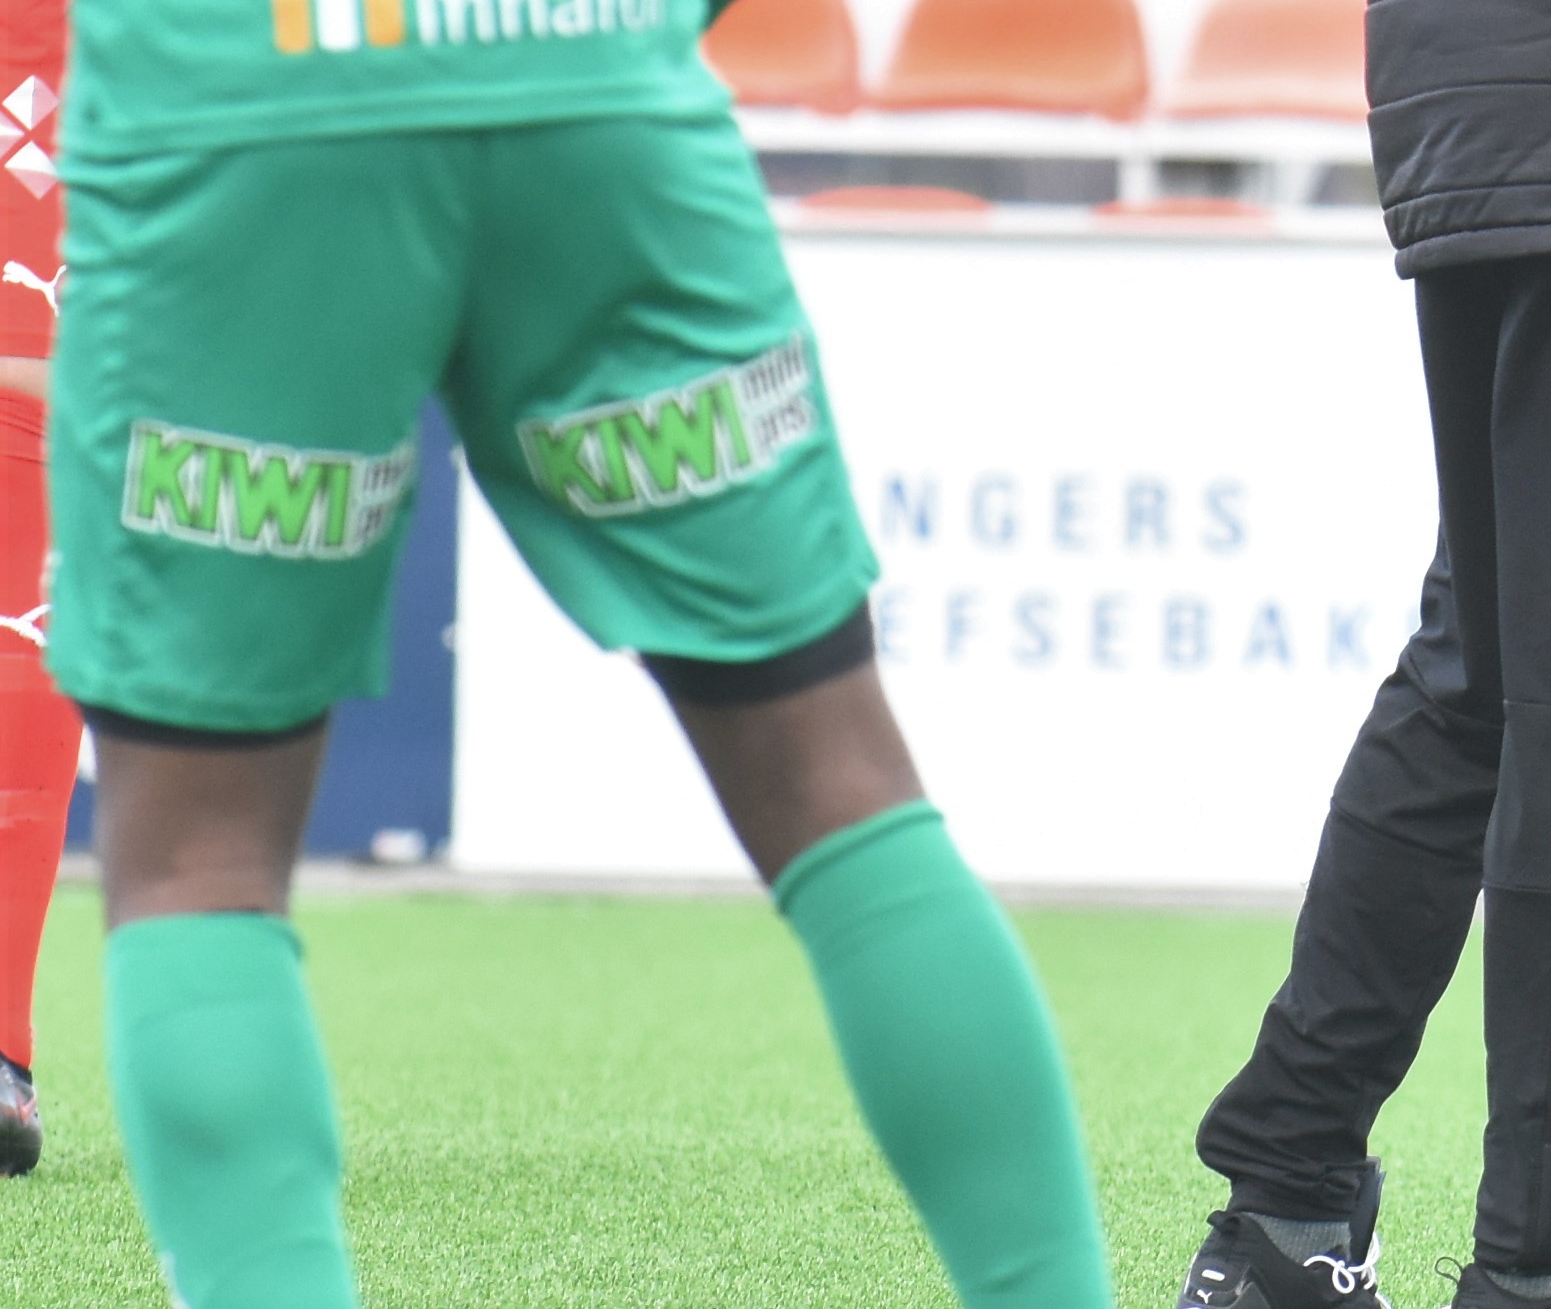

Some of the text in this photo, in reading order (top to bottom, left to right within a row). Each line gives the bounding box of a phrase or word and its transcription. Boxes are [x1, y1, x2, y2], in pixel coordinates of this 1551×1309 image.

[135, 431, 353, 548] KIWI
[533, 377, 751, 504] KIWI
[880, 470, 1252, 558] NGERS
[876, 589, 1420, 674] EFSEBAK
